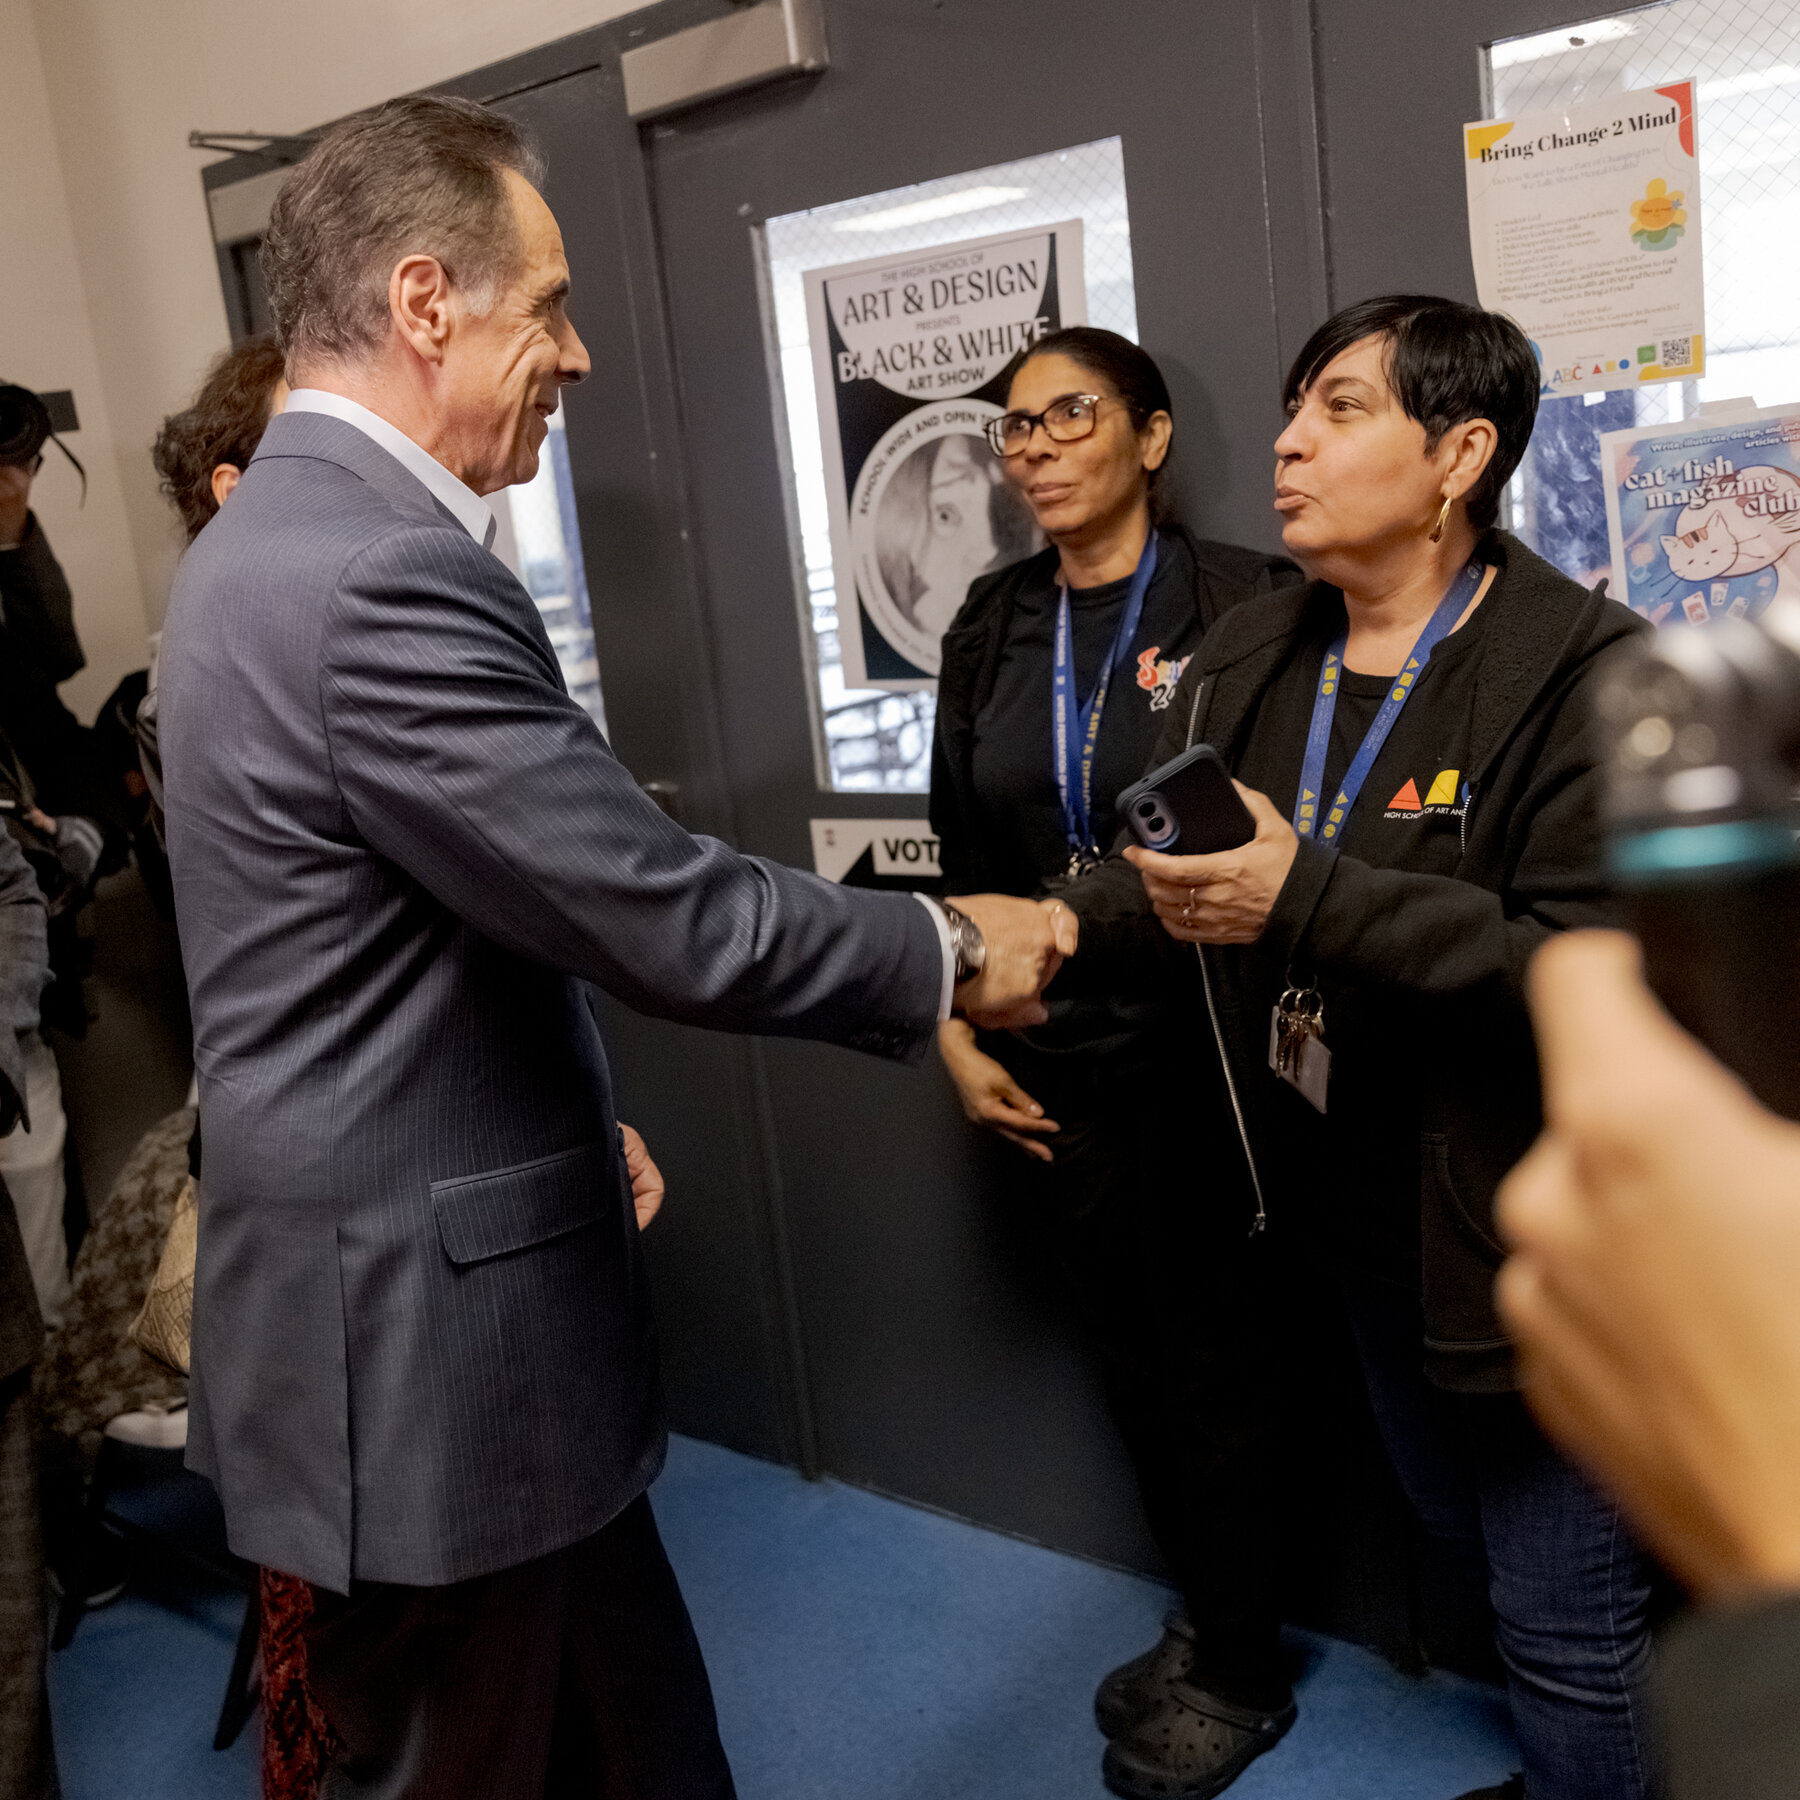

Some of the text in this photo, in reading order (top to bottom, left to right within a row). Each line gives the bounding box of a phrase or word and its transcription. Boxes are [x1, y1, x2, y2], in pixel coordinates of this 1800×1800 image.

[1480, 107, 1677, 164] Bring Change 2 Mind
[881, 271, 899, 283] THE
[843, 259, 1039, 327] ART & DESIGN
[916, 314, 962, 331] PRESENTS
[837, 316, 1050, 383] BLACK & WHITE
[907, 366, 986, 392] ART SHOW
[1553, 364, 1583, 383] ABC
[915, 415, 941, 433] AND
[943, 411, 977, 424] OPEN
[1744, 437, 1780, 449] articles
[1624, 467, 1667, 491] cat
[1682, 455, 1734, 482] fish
[1646, 474, 1779, 510] magazine
[1743, 489, 1800, 517] club
[1086, 712, 1100, 739] ART
[1401, 810, 1424, 820] SCHO
[1424, 806, 1435, 814] OF
[884, 839, 940, 862] VOT
